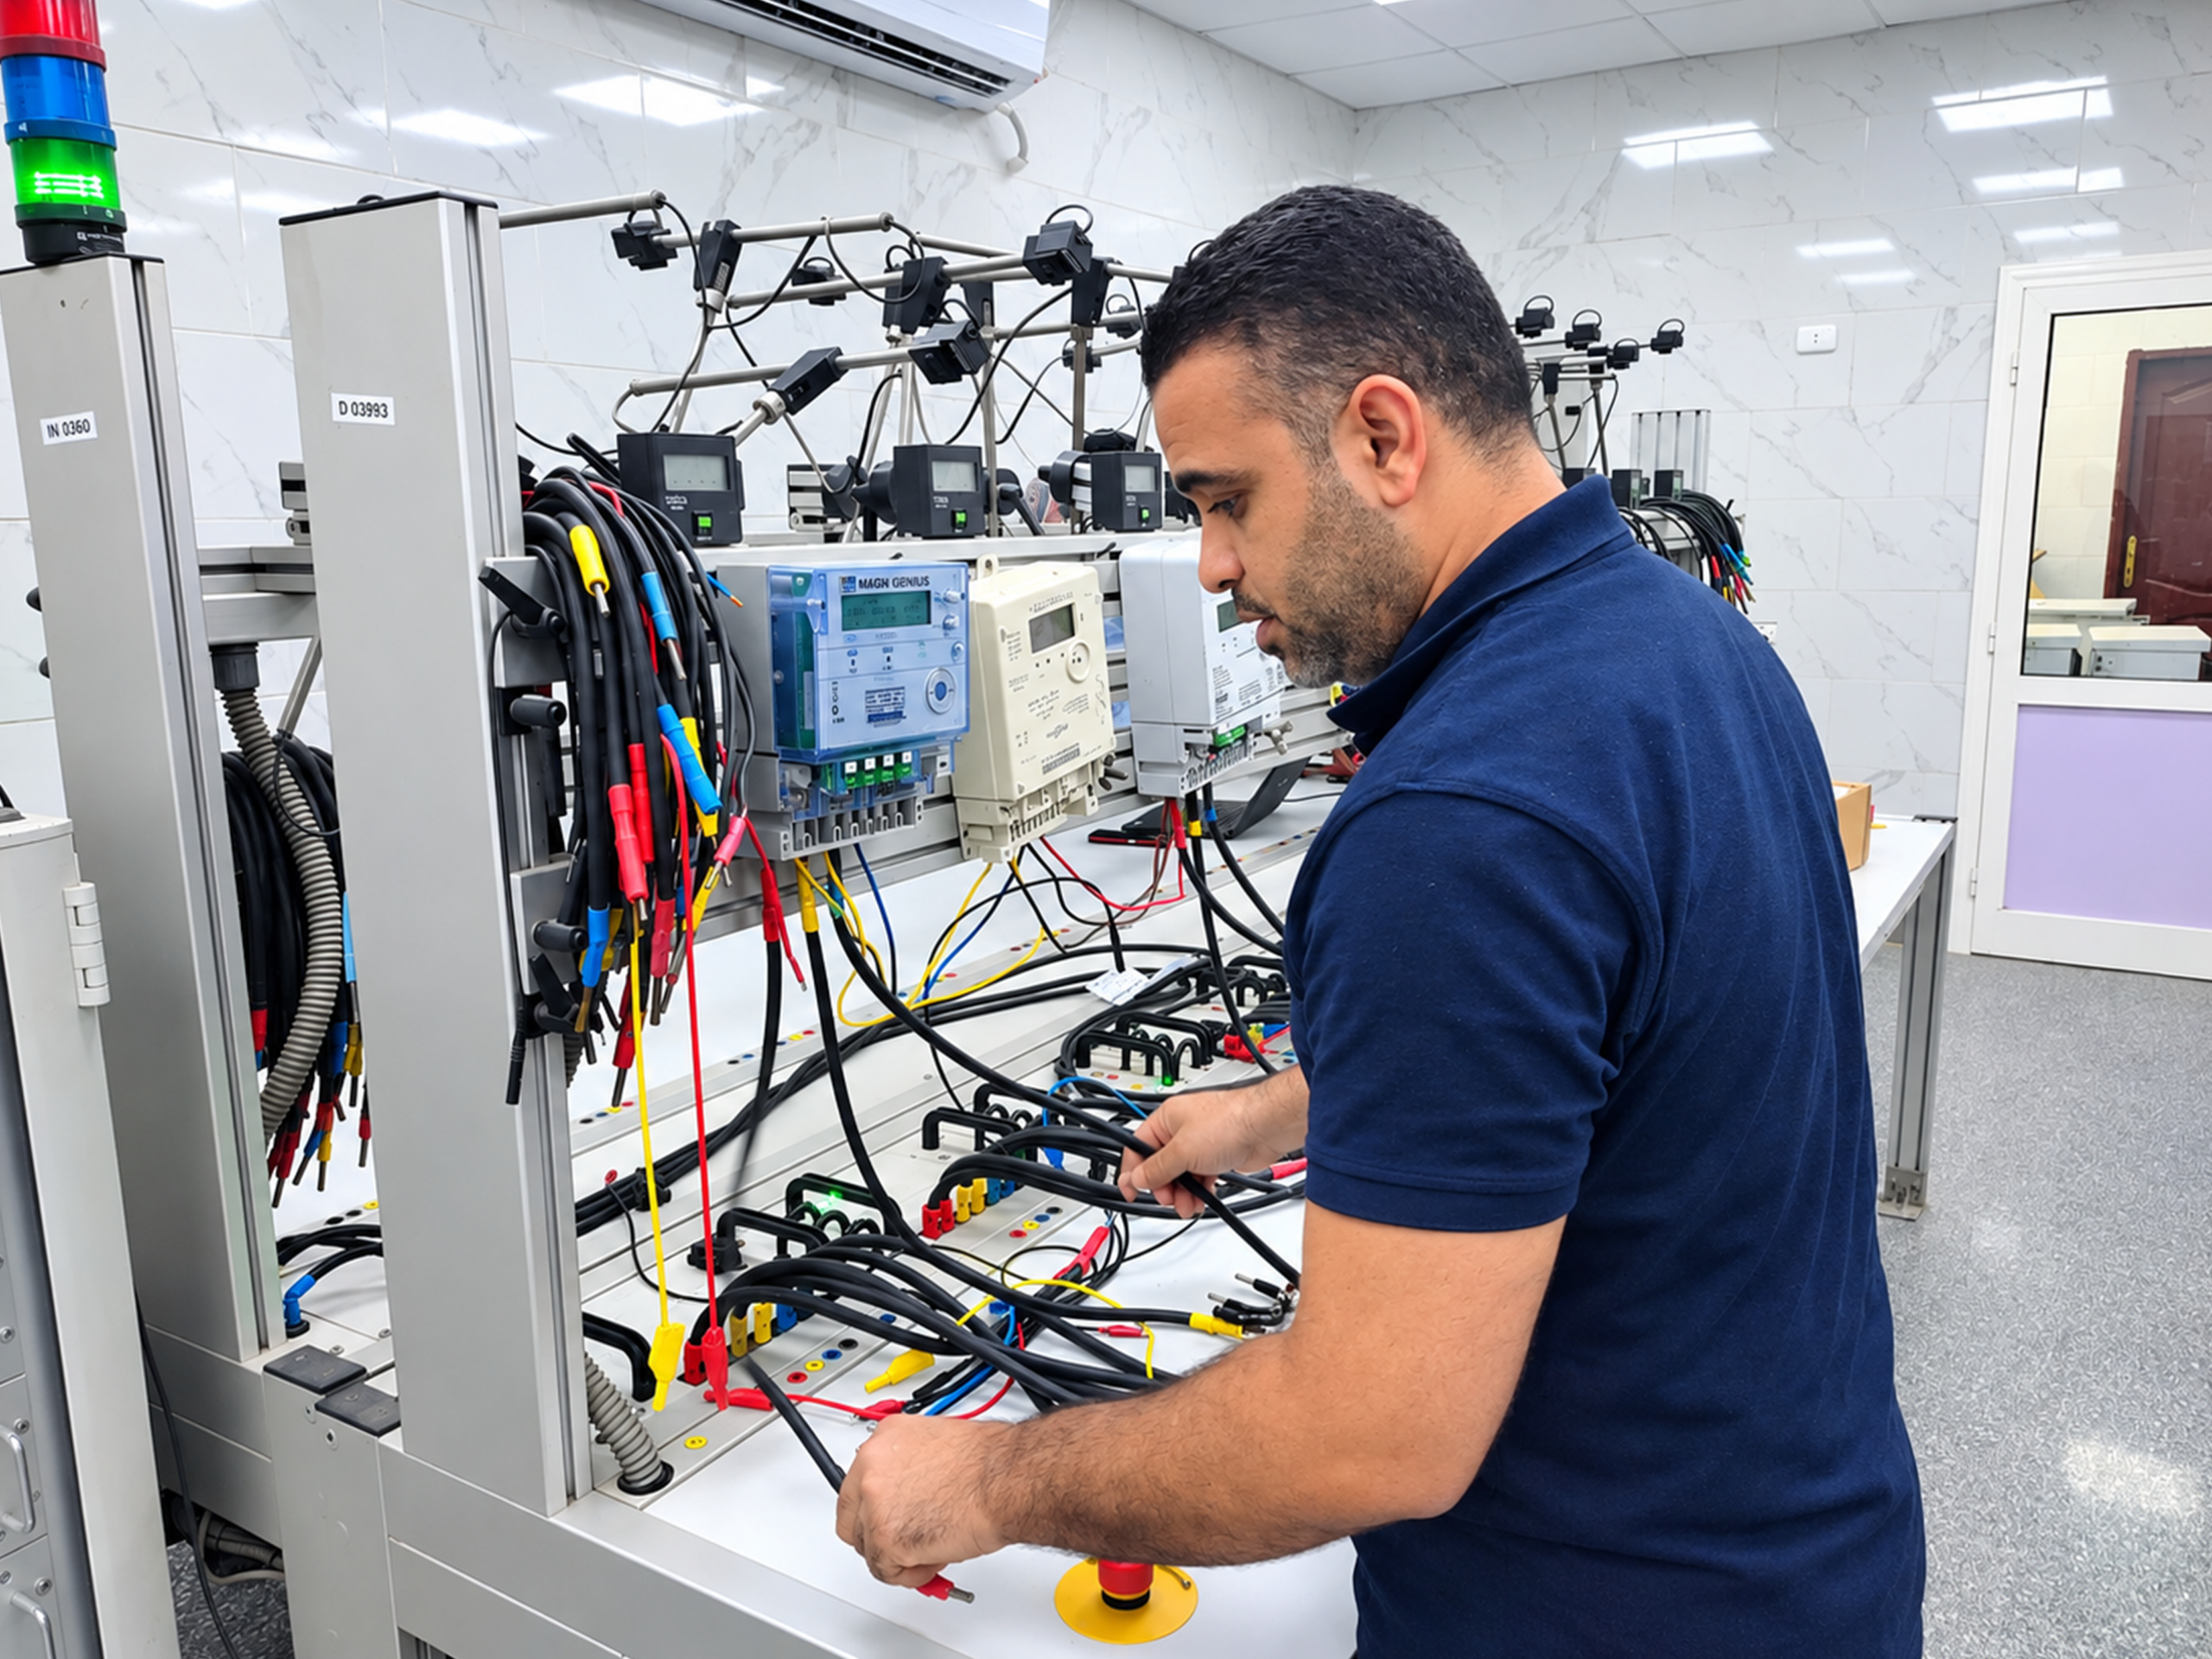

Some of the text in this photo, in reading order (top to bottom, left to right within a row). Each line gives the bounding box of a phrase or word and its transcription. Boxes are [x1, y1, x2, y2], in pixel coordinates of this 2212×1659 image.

[338, 400, 349, 416] D
[47, 418, 91, 439] IN 0360
[892, 575, 930, 588] GENIUS
